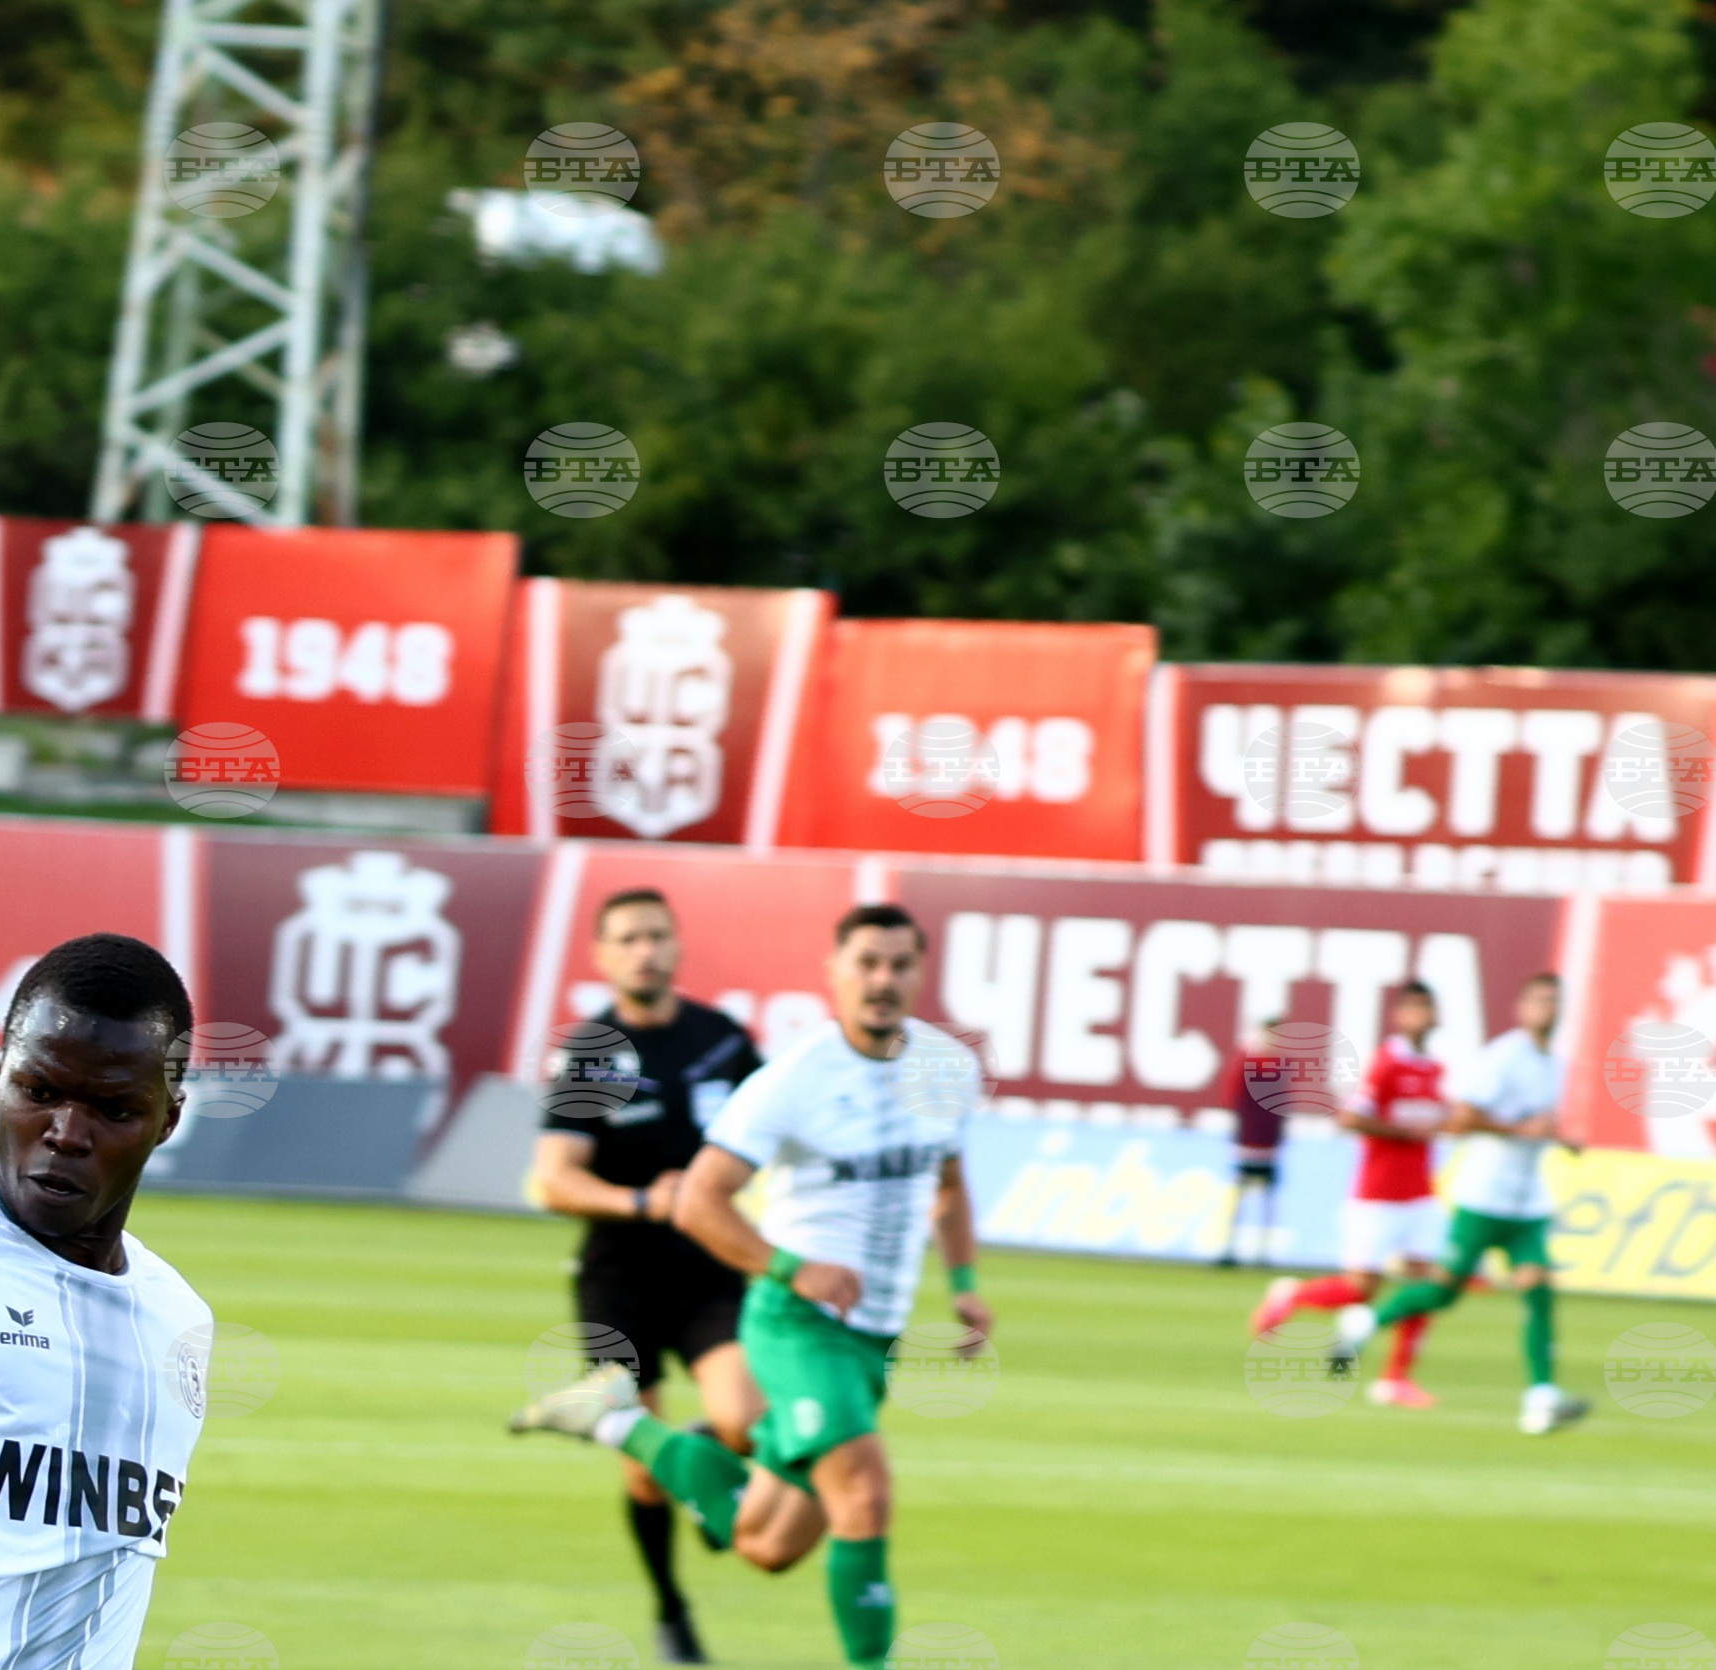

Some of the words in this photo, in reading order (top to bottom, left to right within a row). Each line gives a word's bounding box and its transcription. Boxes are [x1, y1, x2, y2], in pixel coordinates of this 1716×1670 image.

[237, 615, 455, 707] 1948
[867, 711, 1096, 804] 1948
[1199, 703, 1679, 843] ЧЕСТТА
[0, 1330, 50, 1350] erima
